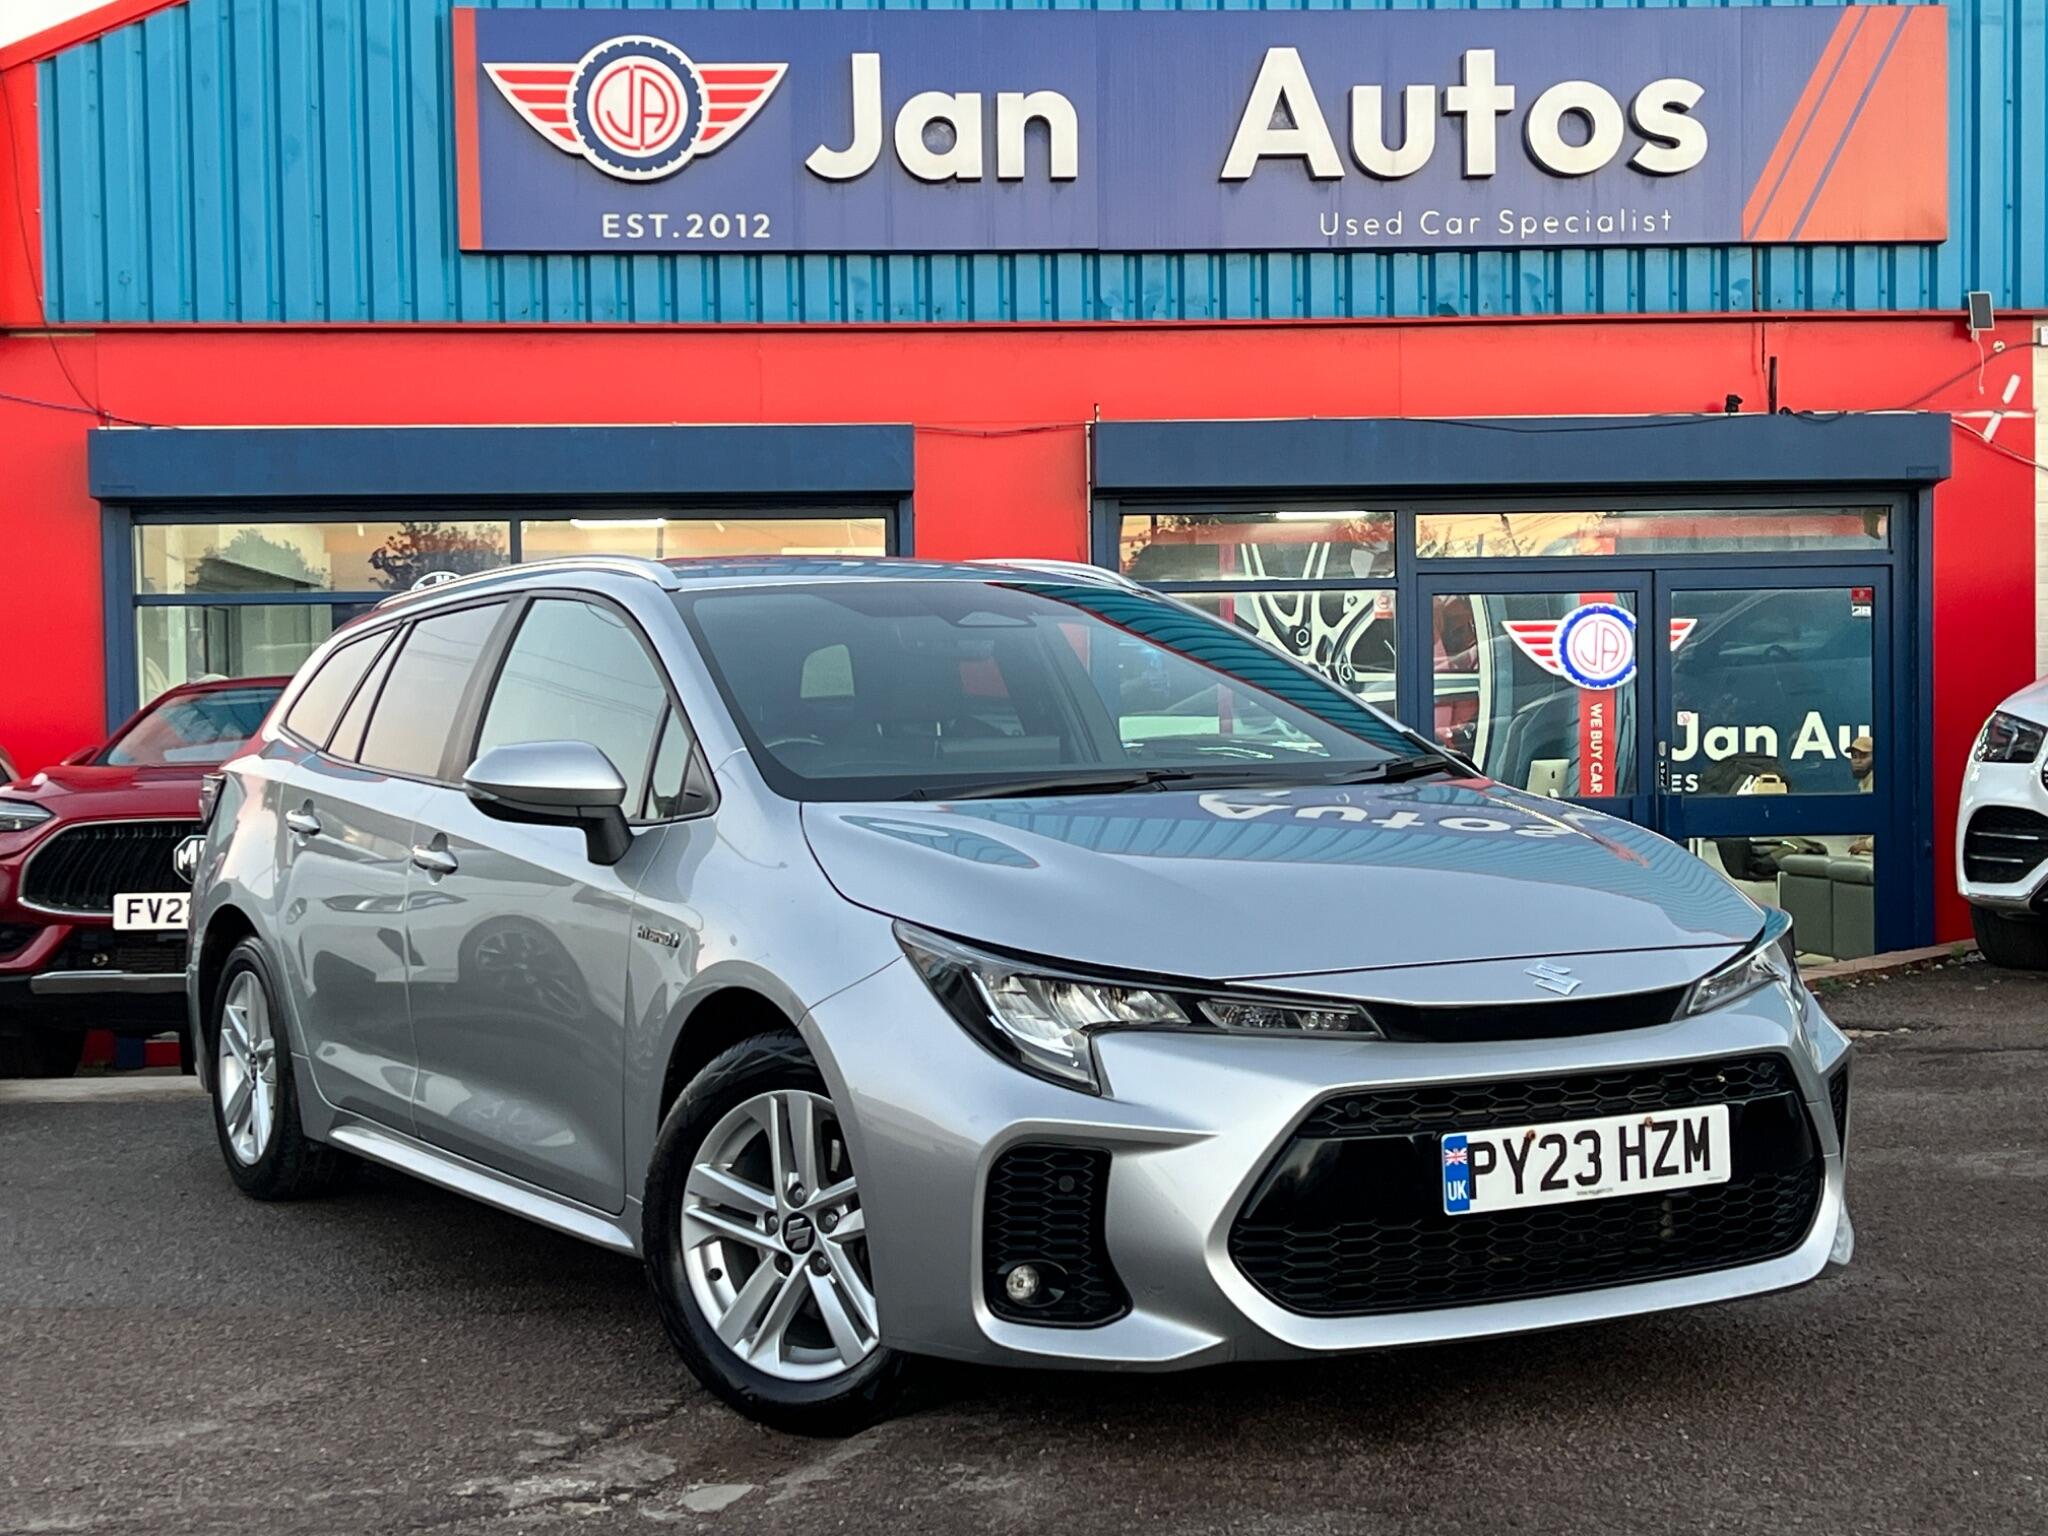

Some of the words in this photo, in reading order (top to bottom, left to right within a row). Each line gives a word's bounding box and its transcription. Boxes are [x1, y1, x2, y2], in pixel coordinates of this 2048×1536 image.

[804, 52, 1079, 181] Jan
[1219, 47, 1709, 180] Autos
[602, 213, 771, 239] EST.2012
[1319, 210, 1402, 236] Used
[1420, 210, 1481, 235] Car
[1498, 208, 1672, 239] Specialist
[1590, 703, 1603, 728] WE
[1590, 730, 1603, 760] BUY
[1671, 711, 1778, 761] Jan
[1590, 762, 1603, 793] CAR
[127, 898, 190, 924] FV2
[1468, 1130, 1603, 1200] PY23
[1618, 1116, 1711, 1182] HZM
[1447, 1180, 1468, 1201] UK
